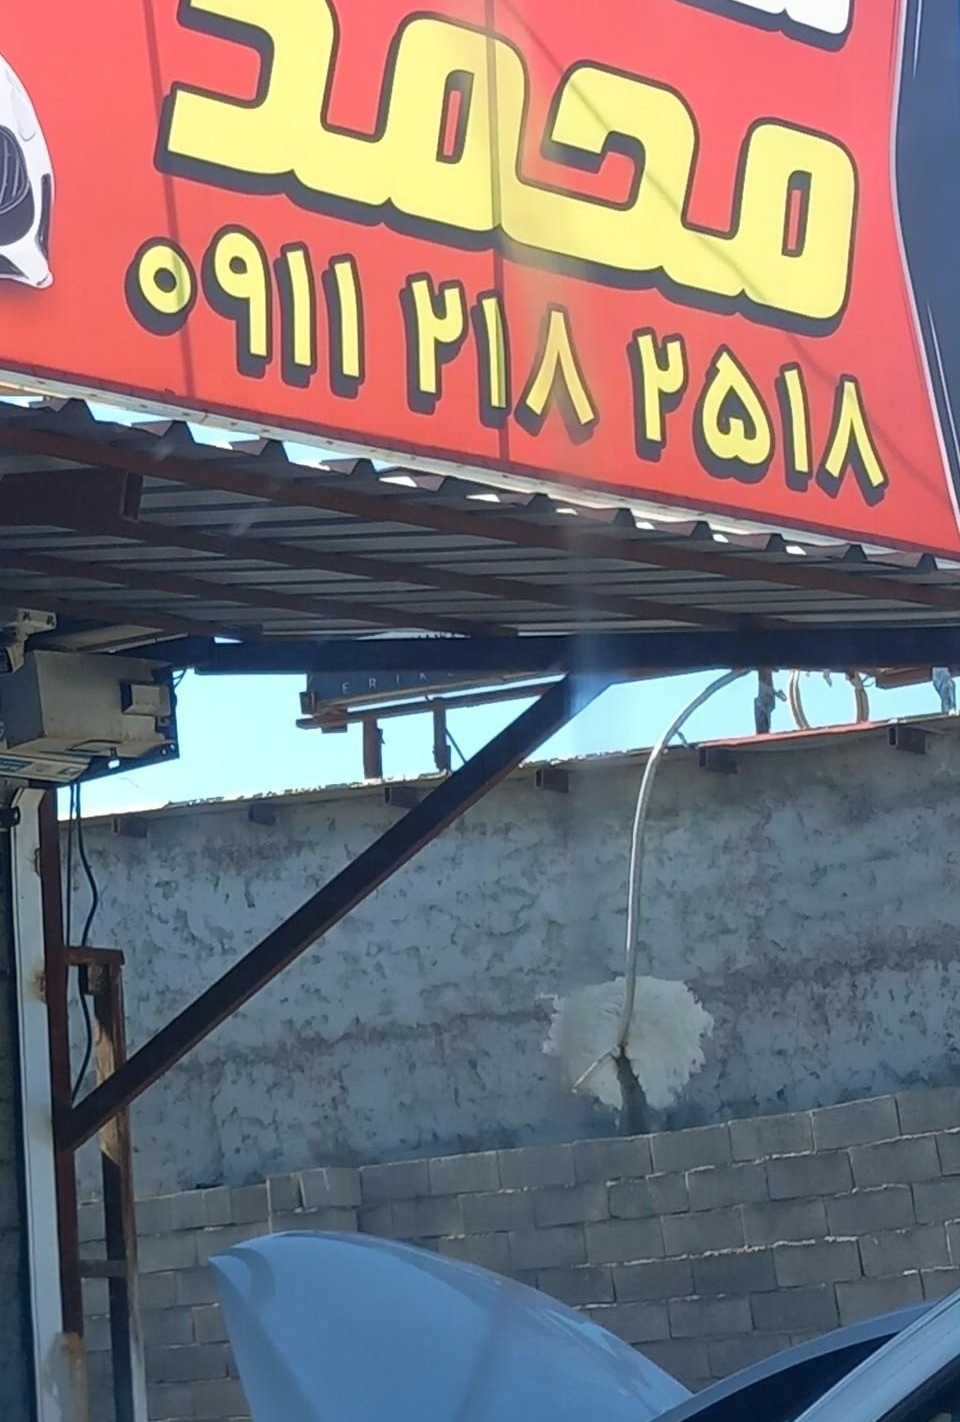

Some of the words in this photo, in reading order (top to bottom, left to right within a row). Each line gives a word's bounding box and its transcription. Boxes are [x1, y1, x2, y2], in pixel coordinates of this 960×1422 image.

[125, 225, 364, 385] ۰۹۱۱
[403, 273, 597, 446] ۲۱۸
[632, 329, 888, 505] ۲۵۱۸
